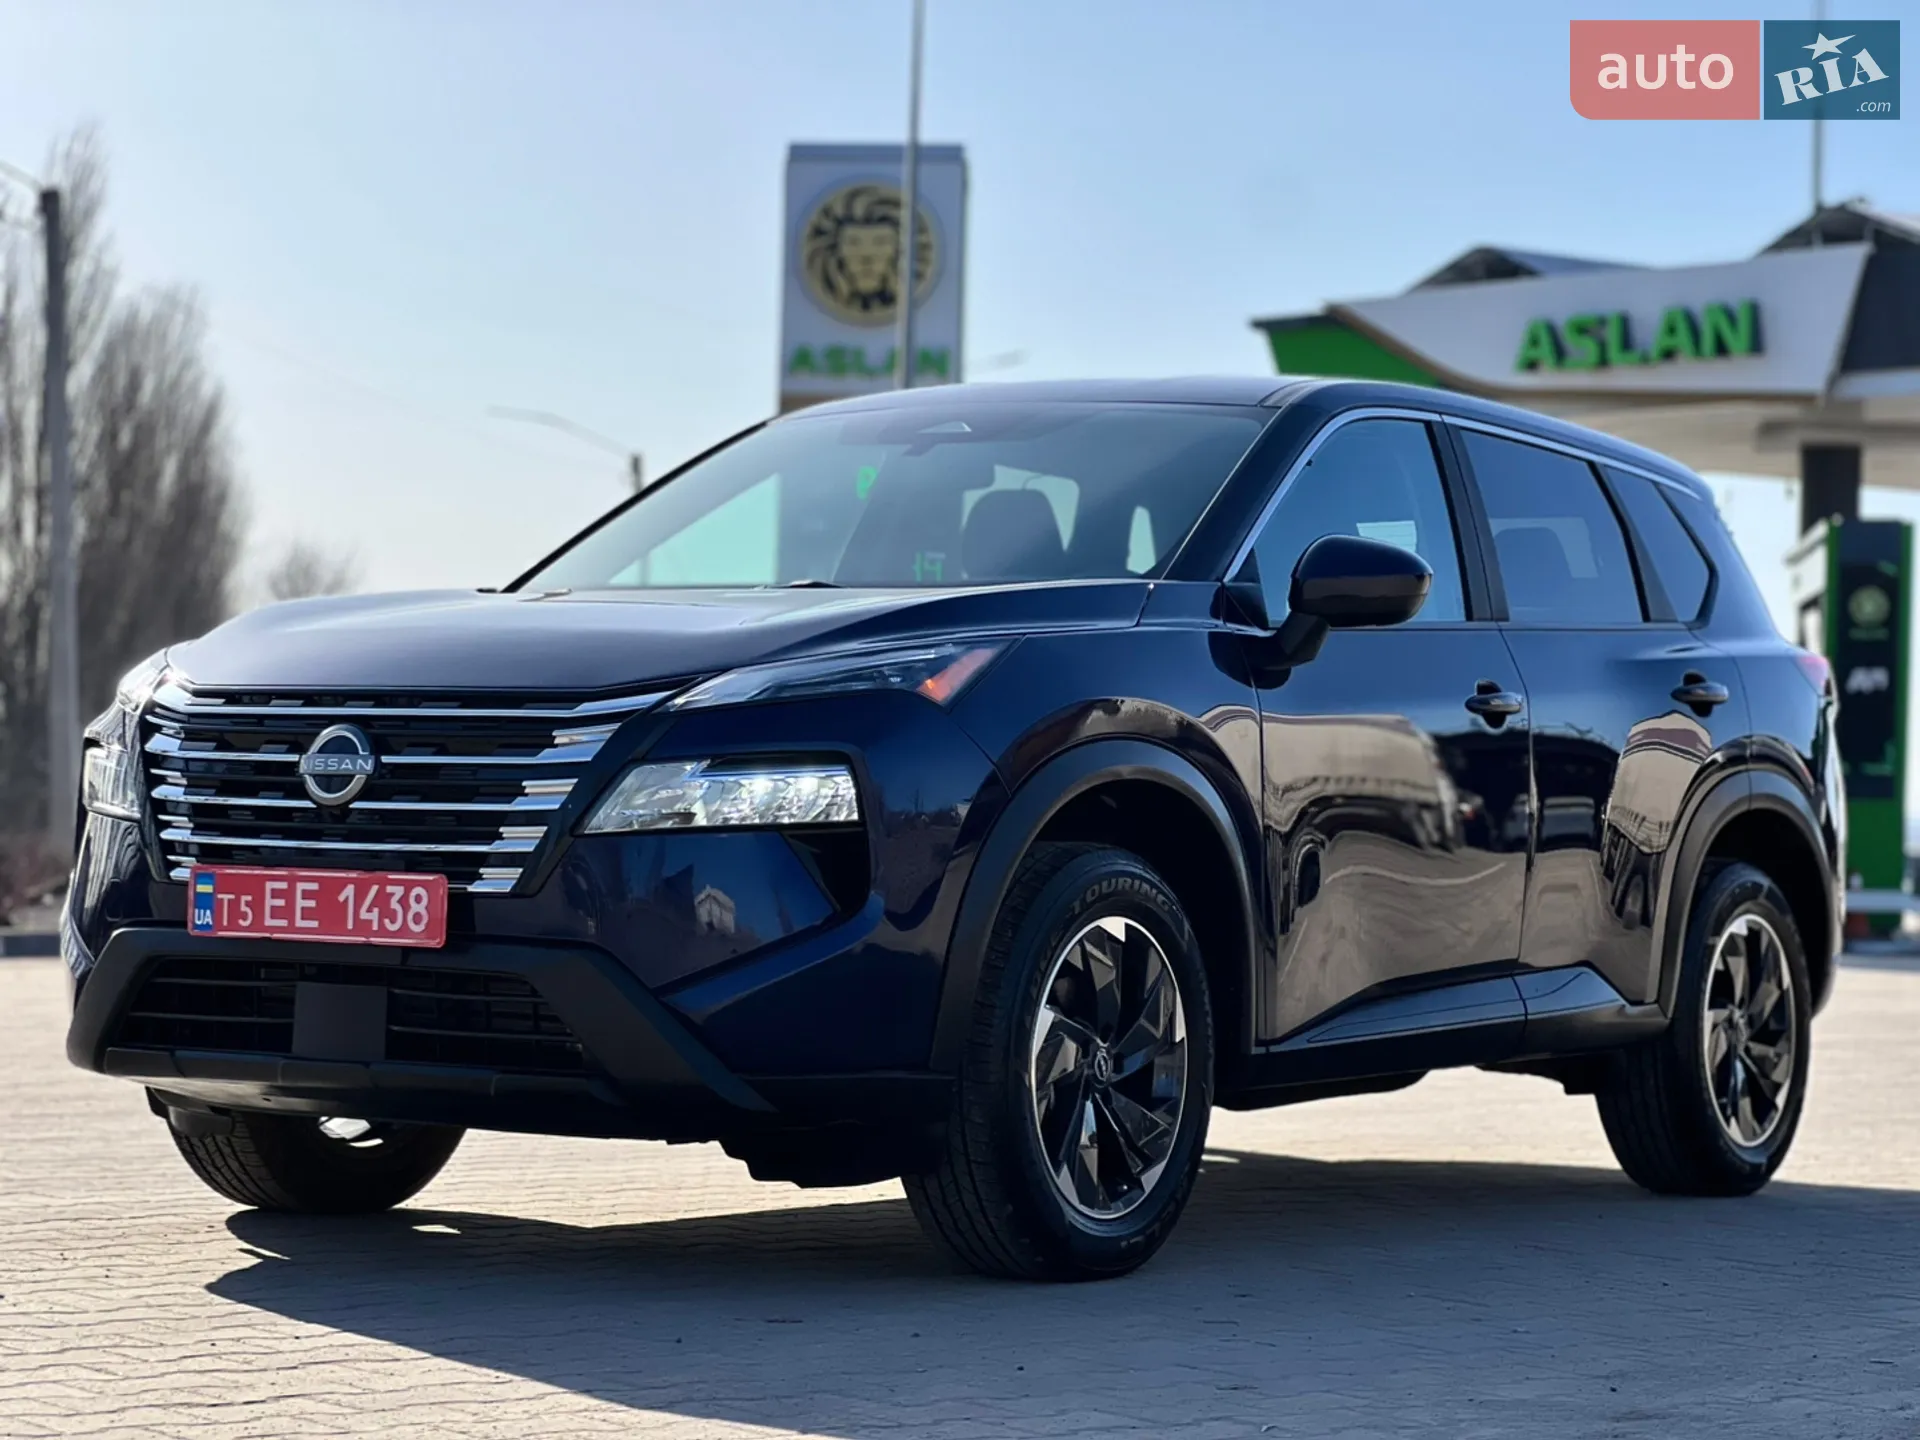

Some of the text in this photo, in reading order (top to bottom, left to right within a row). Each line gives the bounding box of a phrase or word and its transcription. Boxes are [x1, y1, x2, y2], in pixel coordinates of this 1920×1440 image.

[1515, 298, 1764, 374] ASLAN
[194, 908, 213, 926] UA
[217, 881, 429, 933] T5 EE 1438
[1070, 877, 1170, 915] TOURING
